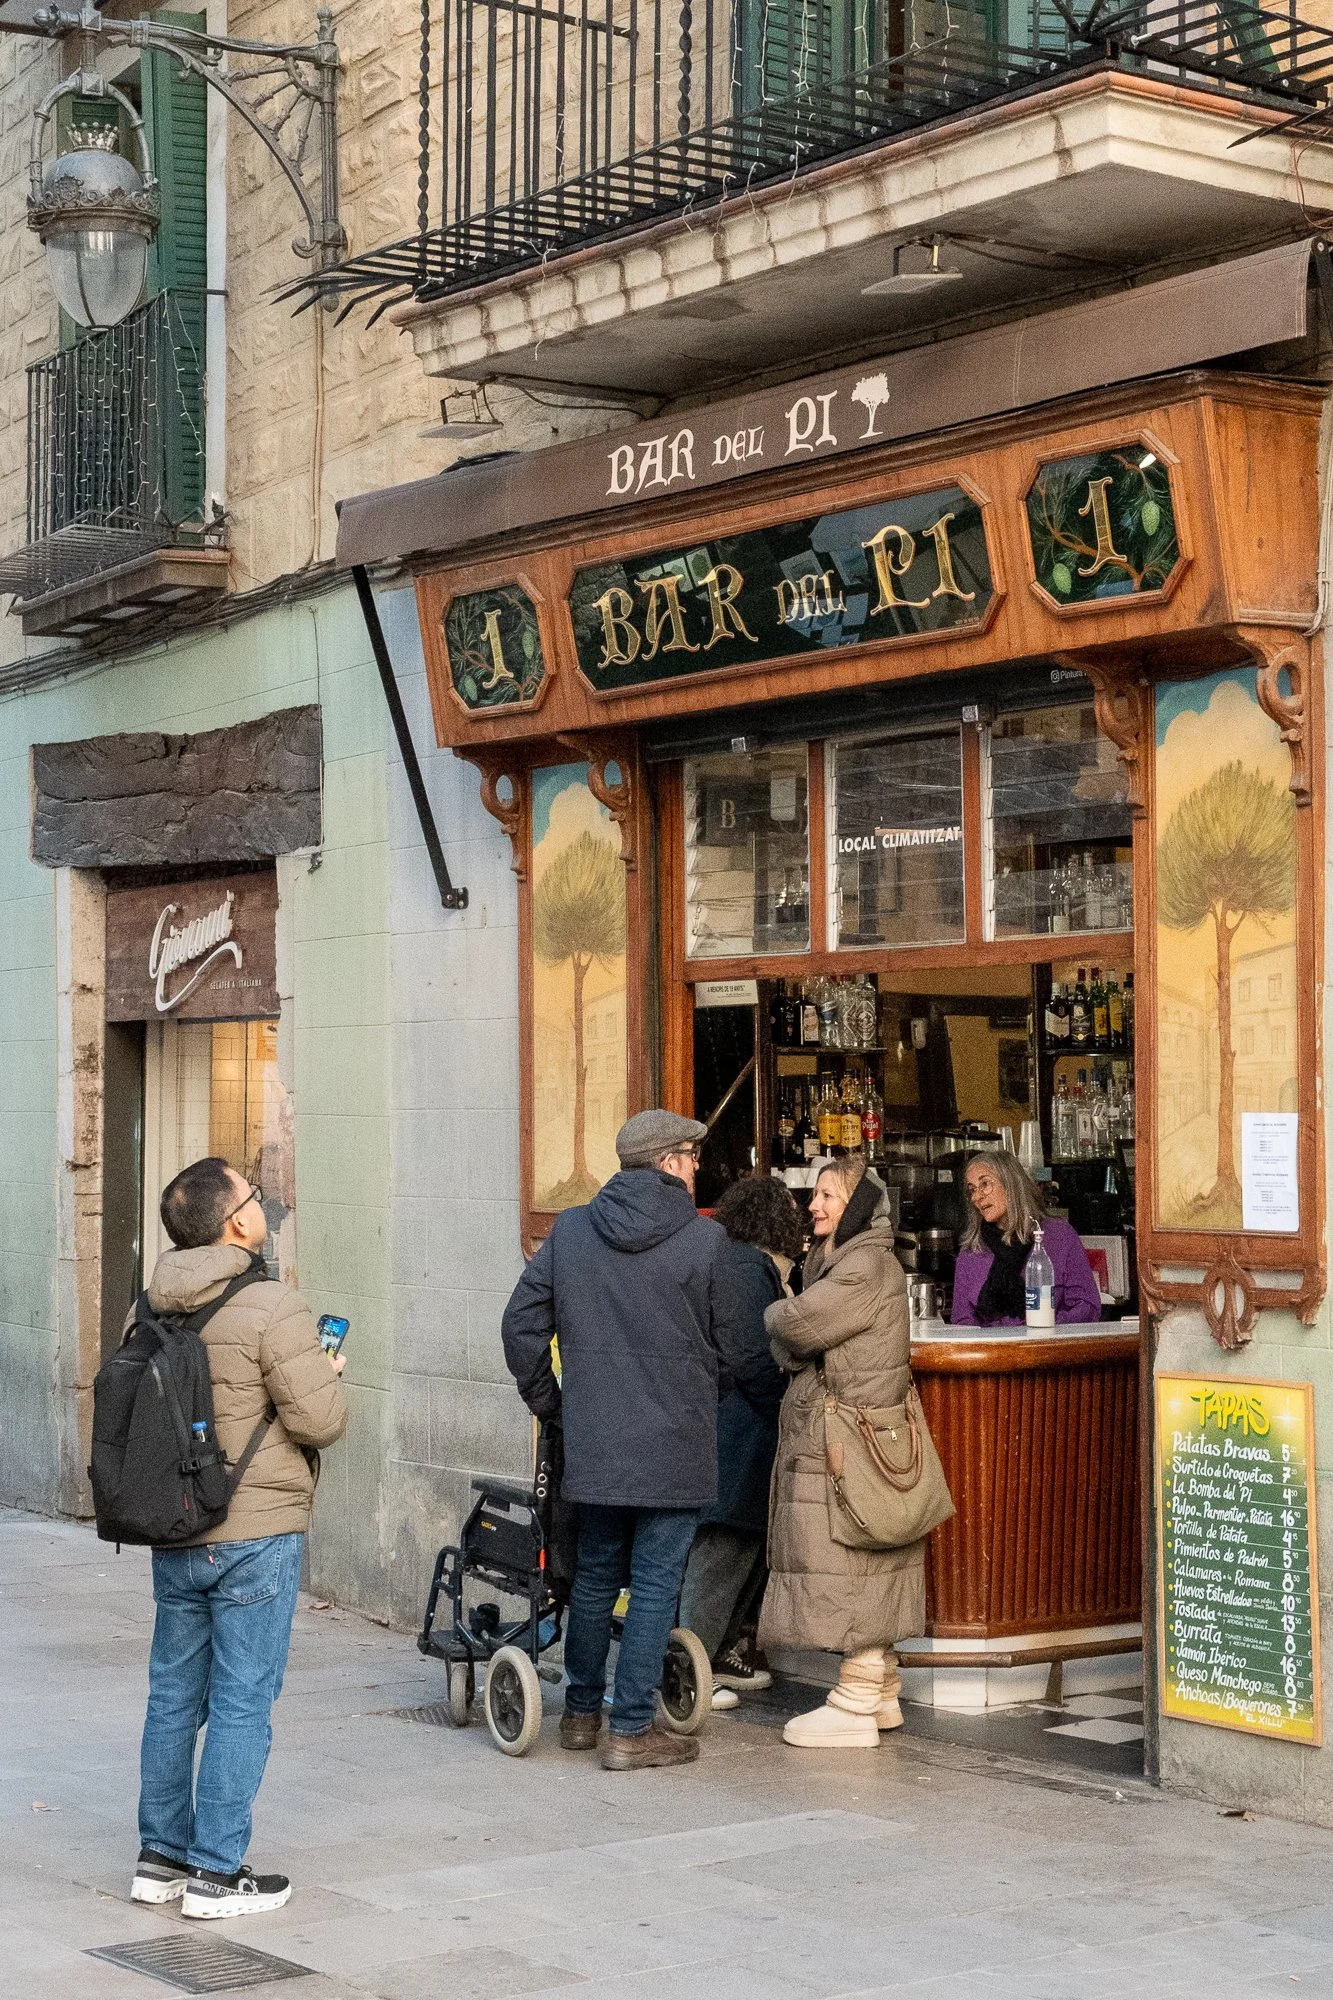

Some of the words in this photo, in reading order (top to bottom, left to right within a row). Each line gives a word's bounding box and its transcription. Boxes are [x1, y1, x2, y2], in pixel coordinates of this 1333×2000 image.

[605, 428, 695, 496] BAR
[711, 425, 765, 467] DEL
[784, 390, 838, 457] PI
[591, 563, 759, 669] BAR
[772, 569, 848, 626] DEL
[861, 512, 976, 617] PI
[720, 800, 736, 828] B
[838, 836, 876, 853] LOCAL
[882, 826, 960, 848] CLIMATITZAT
[1188, 1388, 1270, 1438] TAPAS
[1172, 1431, 1221, 1456] Patatas
[1224, 1438, 1270, 1462] Bravas
[1172, 1456, 1214, 1477] Surtido
[1222, 1463, 1273, 1488] Croquetas
[1172, 1474, 1185, 1494] La
[1188, 1479, 1221, 1499] Bomba
[1223, 1483, 1235, 1501] del
[1240, 1486, 1252, 1503] Pi
[1172, 1496, 1197, 1520] Pulpo
[1203, 1501, 1246, 1523] Parmentier
[1250, 1508, 1273, 1527] Patata
[1172, 1517, 1203, 1537] Tortilla
[1206, 1523, 1217, 1538] de
[1219, 1525, 1248, 1545] Patata
[1174, 1538, 1221, 1561] Pimientos
[1223, 1548, 1235, 1562] de
[1237, 1551, 1269, 1569] Padrón
[1173, 1558, 1222, 1582] Calamares
[1234, 1569, 1270, 1590] Romana
[1173, 1578, 1205, 1600] Huevos
[1206, 1584, 1253, 1607] Estrellados
[1173, 1600, 1217, 1621] Tostada
[1174, 1619, 1222, 1644] Burrata
[1285, 1635, 1296, 1654] 8
[1176, 1638, 1206, 1662] Jamón
[1207, 1646, 1247, 1669] Ibérico
[1176, 1661, 1208, 1682] Queso
[1211, 1665, 1262, 1697] Manchego
